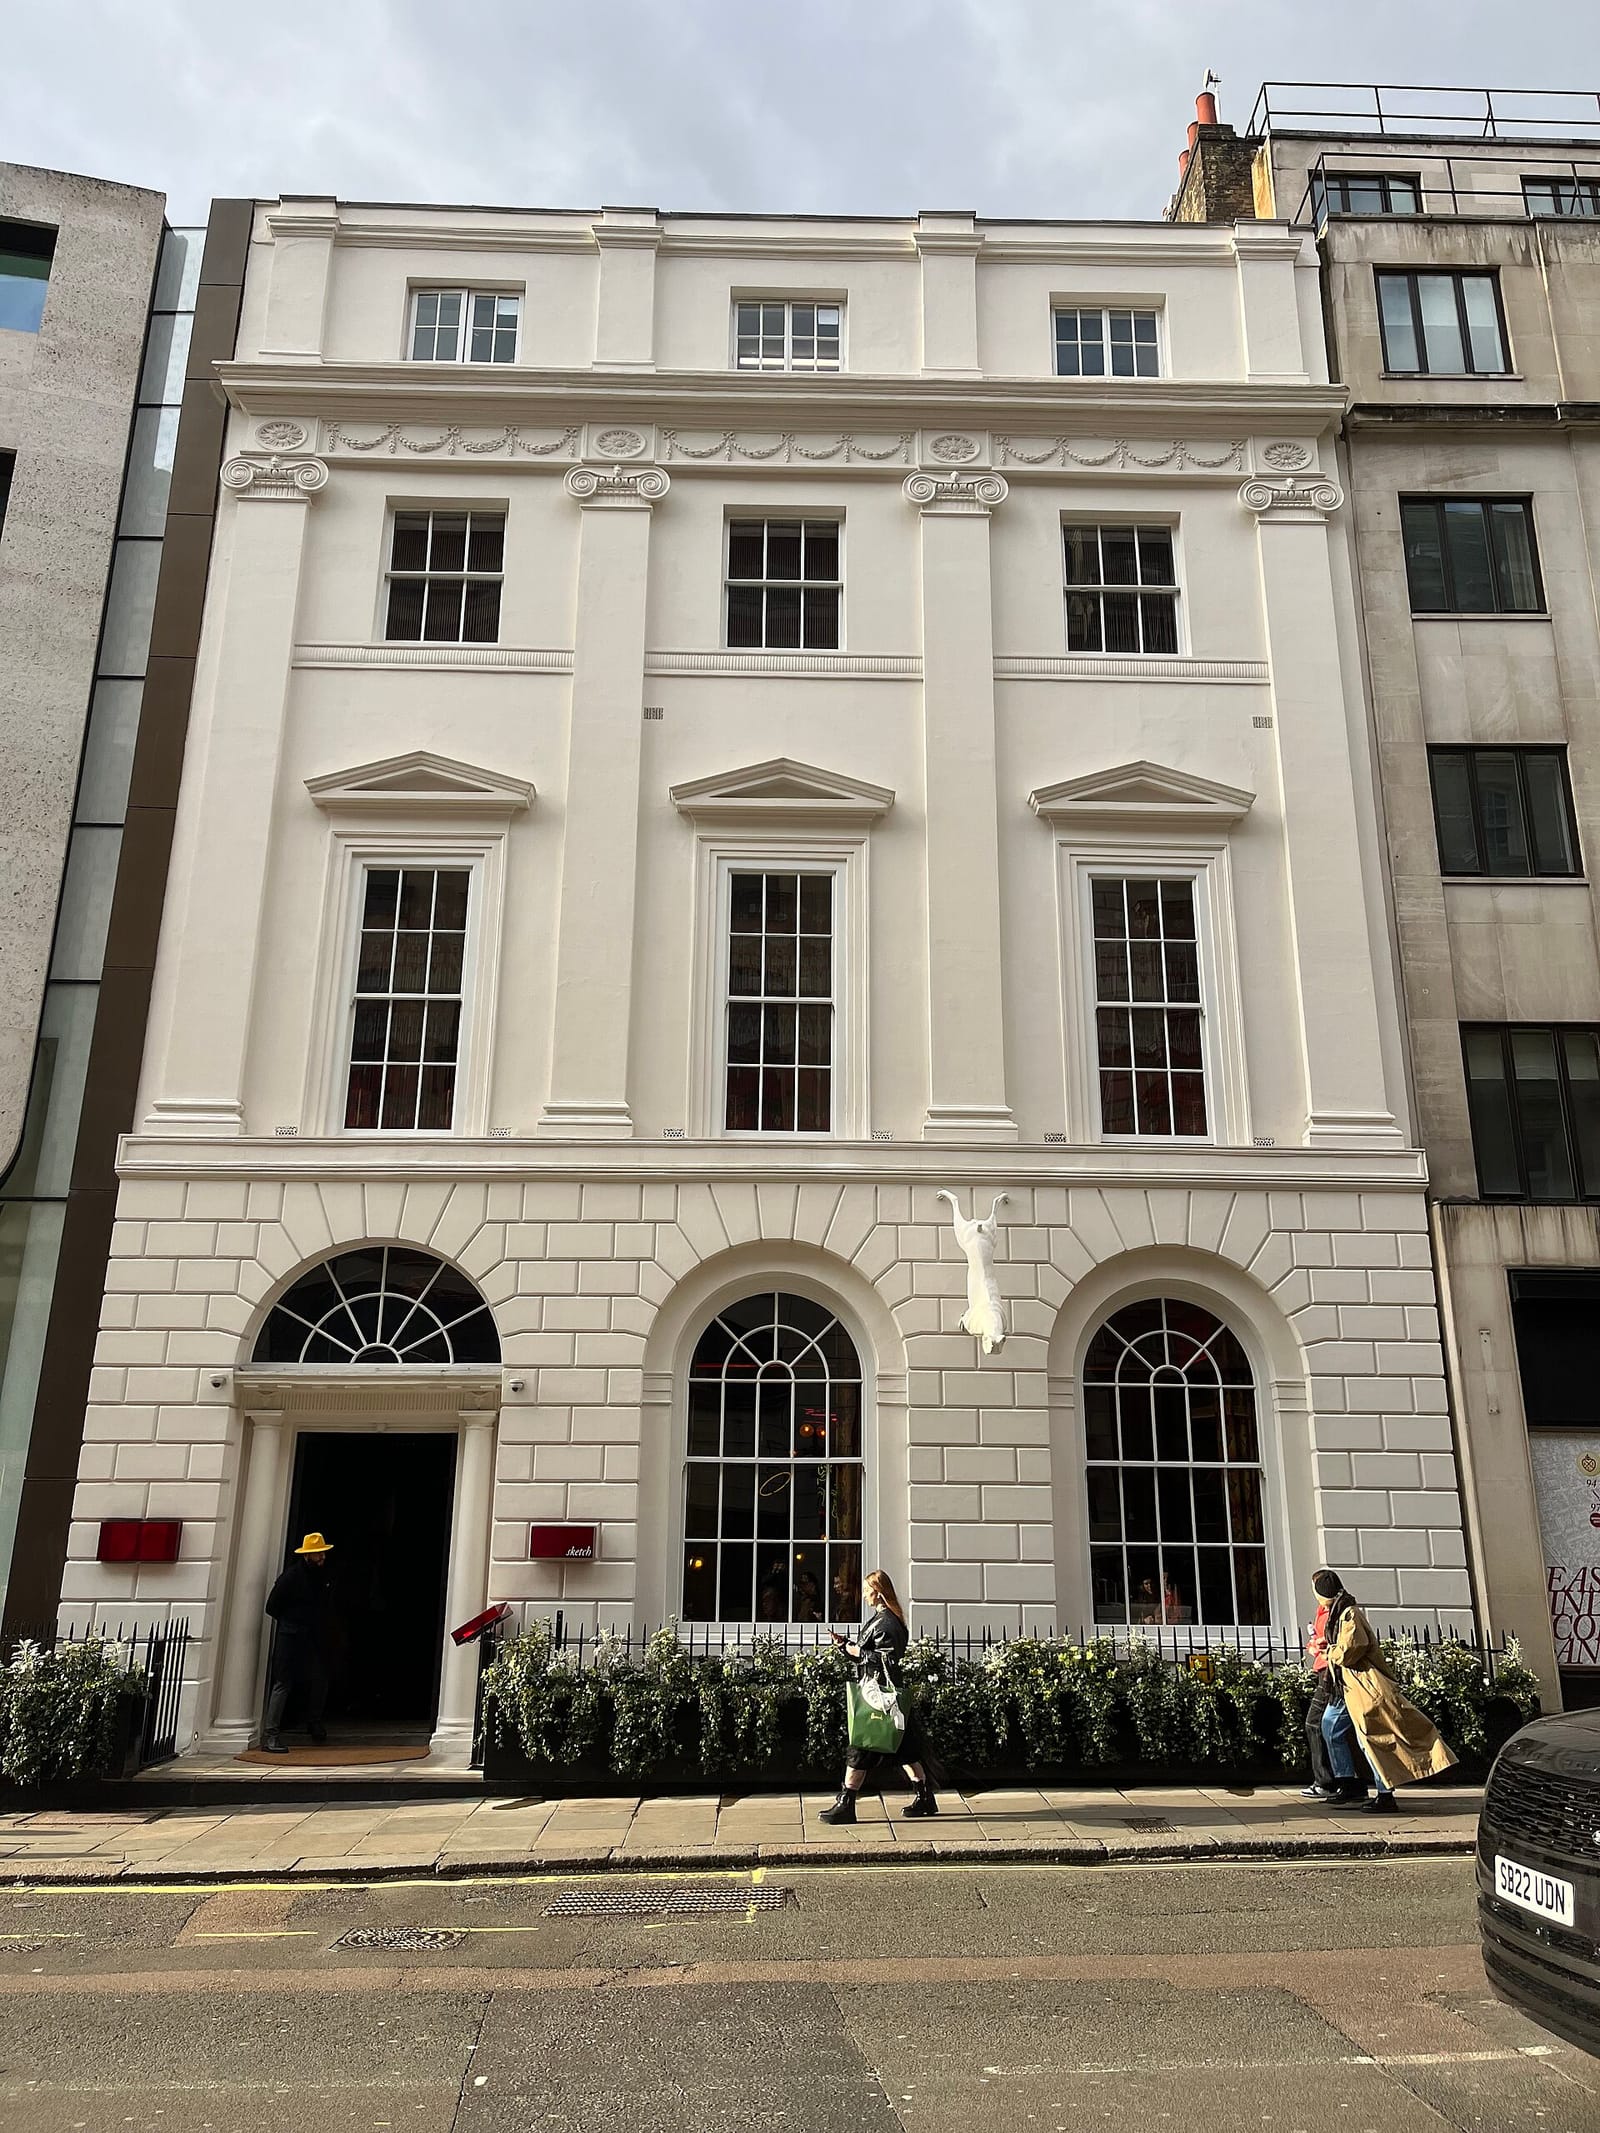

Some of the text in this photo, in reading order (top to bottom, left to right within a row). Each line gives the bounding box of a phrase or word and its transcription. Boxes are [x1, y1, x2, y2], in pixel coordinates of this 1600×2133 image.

[1586, 1479, 1597, 1488] 94
[565, 1546, 592, 1556] sketch
[1553, 1614, 1600, 1640] CO
[1500, 1862, 1565, 1915] SB22 UDN
